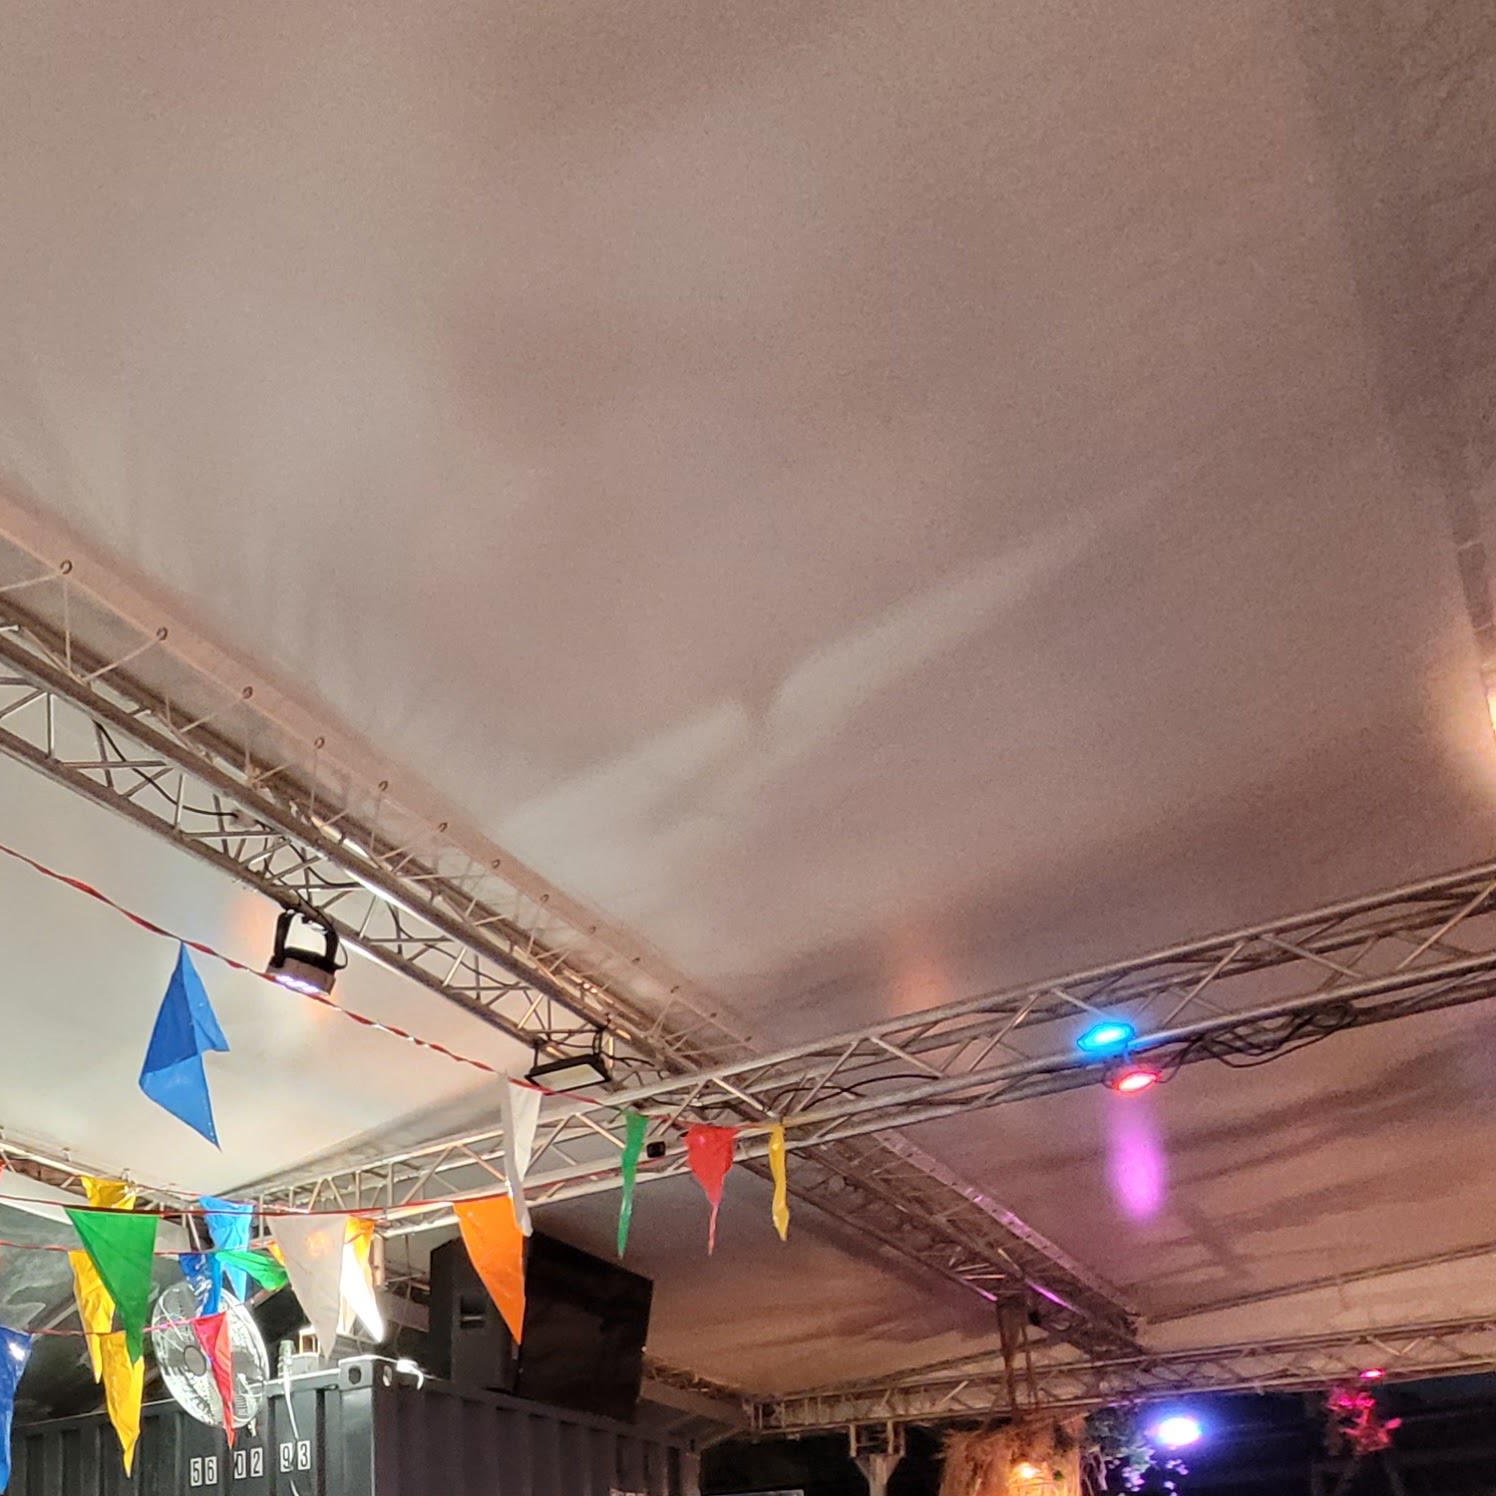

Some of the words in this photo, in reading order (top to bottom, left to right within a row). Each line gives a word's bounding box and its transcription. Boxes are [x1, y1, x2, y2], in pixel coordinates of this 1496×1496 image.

[192, 1459, 215, 1484] 56
[235, 1450, 261, 1476] 02
[282, 1442, 308, 1469] 93
